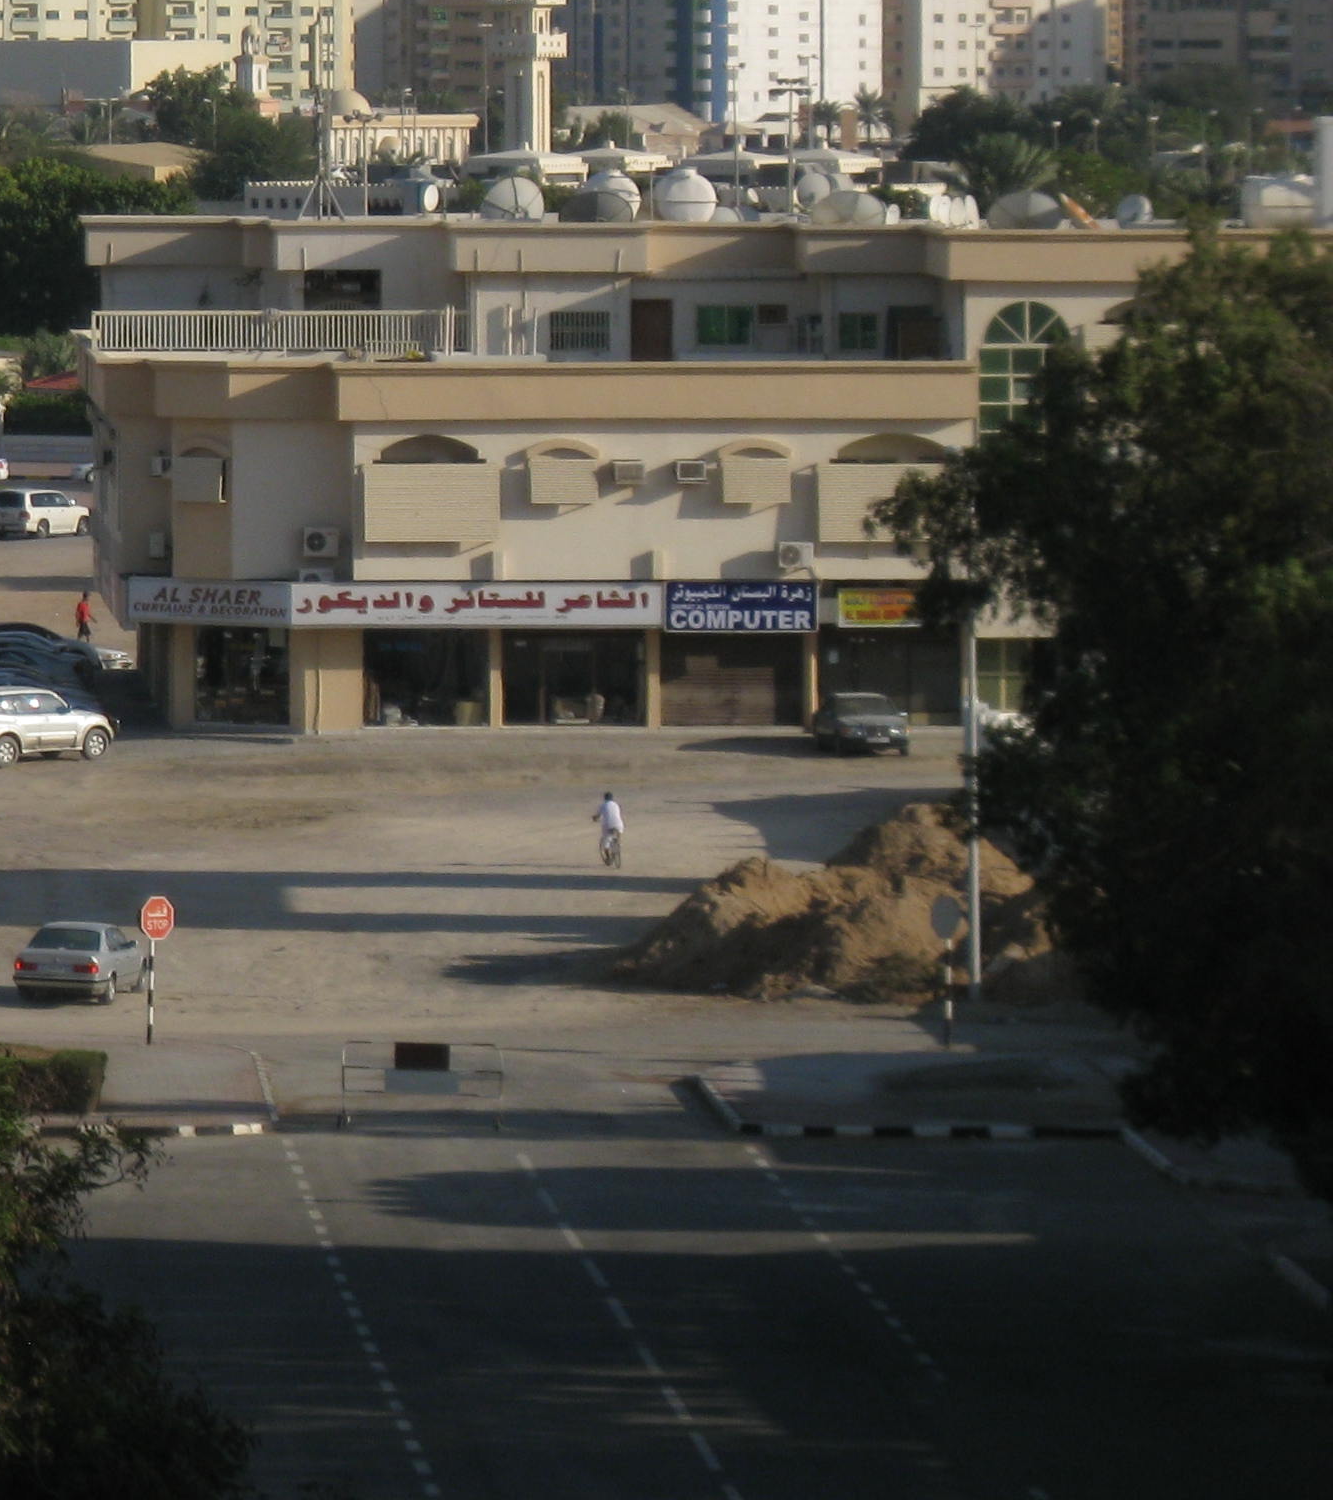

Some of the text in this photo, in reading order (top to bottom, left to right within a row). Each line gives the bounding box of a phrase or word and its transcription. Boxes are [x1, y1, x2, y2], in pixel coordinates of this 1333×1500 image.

[153, 587, 262, 605] AL SHAER
[133, 601, 193, 613] CURTAINS
[210, 605, 288, 618] DECORATION
[670, 610, 811, 630] COMPUTER
[147, 920, 168, 930] STOP
